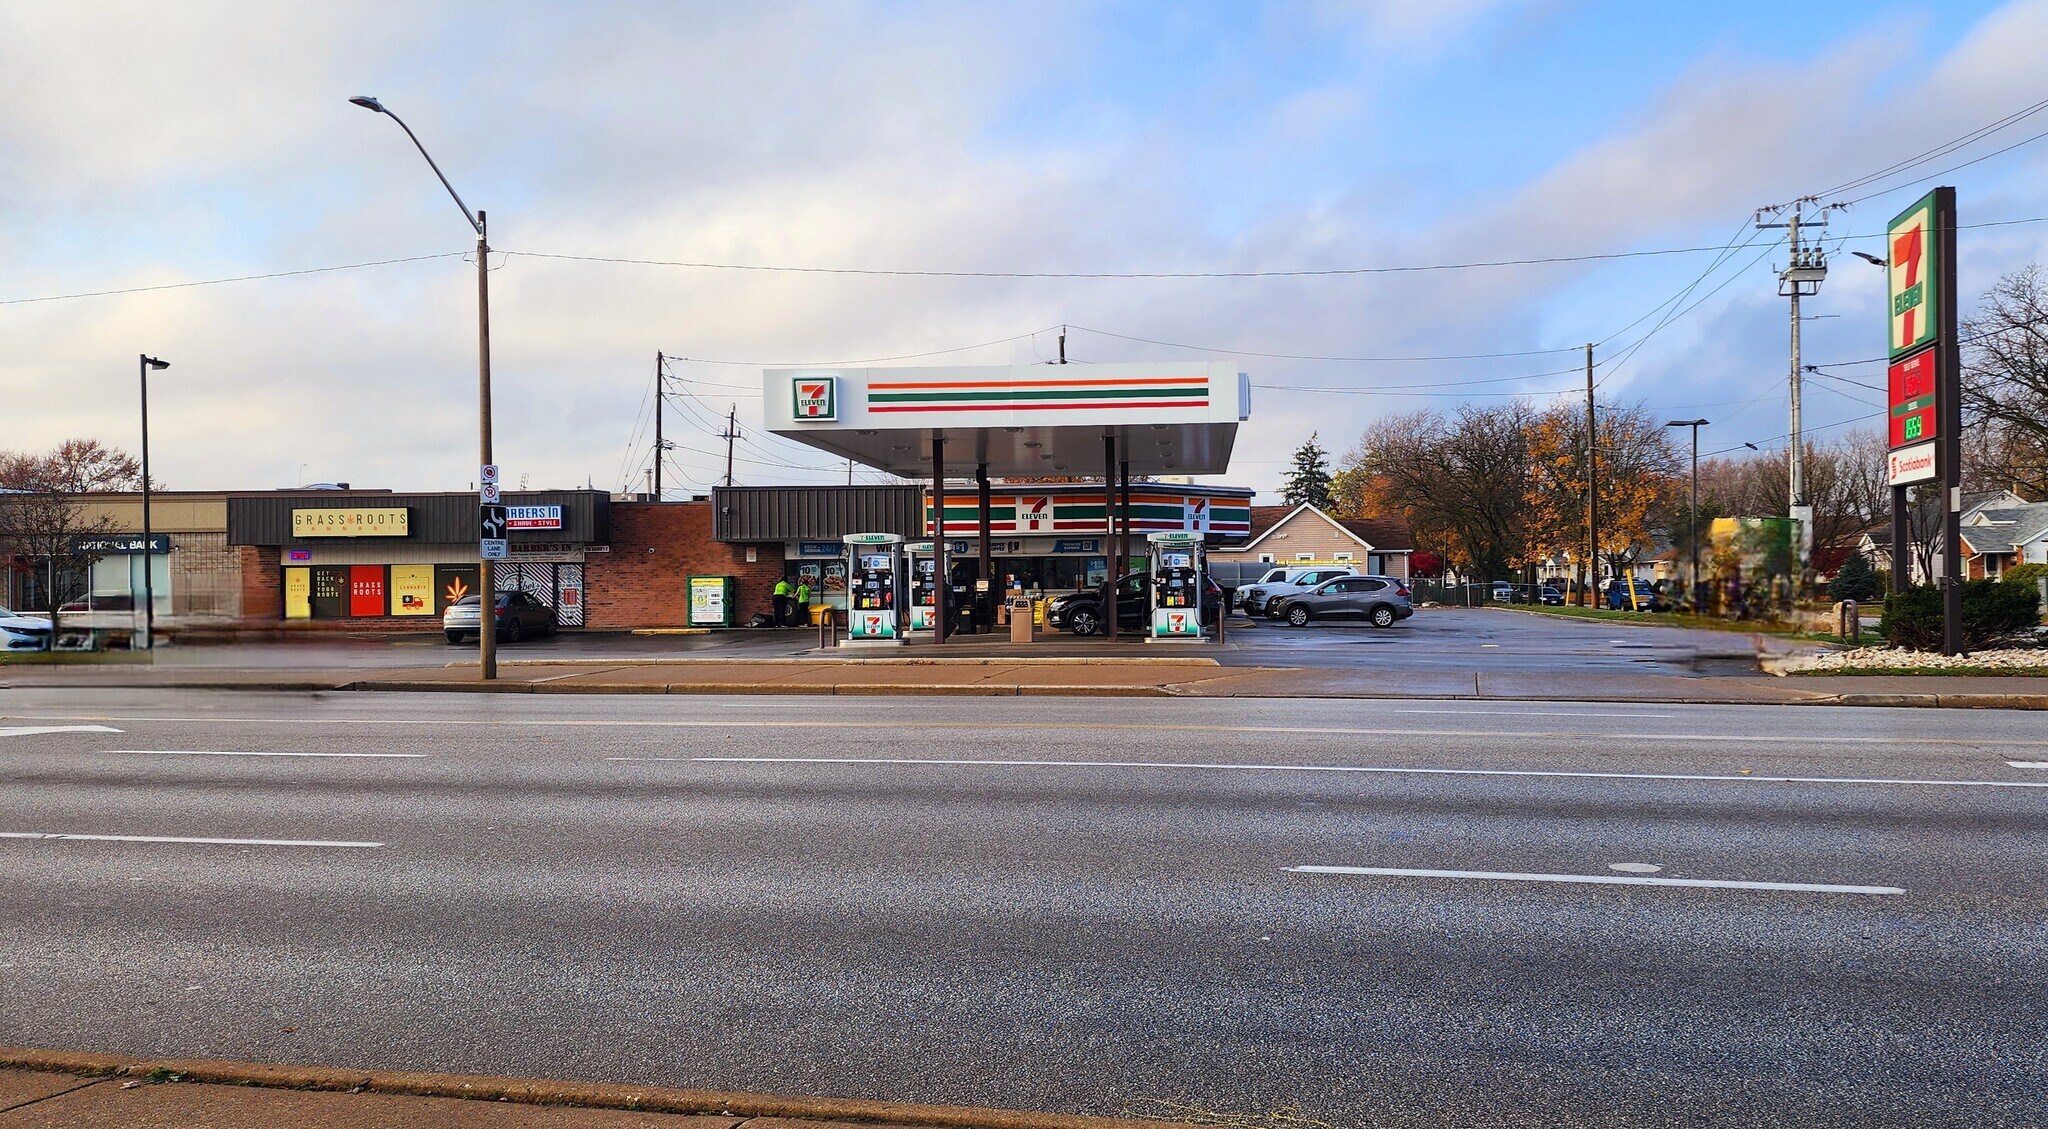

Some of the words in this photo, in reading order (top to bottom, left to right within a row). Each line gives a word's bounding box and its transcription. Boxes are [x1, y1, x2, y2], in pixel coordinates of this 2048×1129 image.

[1894, 222, 1922, 347] 7
[801, 384, 826, 416] 7
[1899, 454, 1932, 473] Scotiabank
[295, 515, 344, 525] GRASS
[356, 514, 406, 524] ROOTS
[1022, 496, 1047, 529] 7
[1188, 498, 1205, 529] 7
[511, 544, 557, 552] BARBER'S
